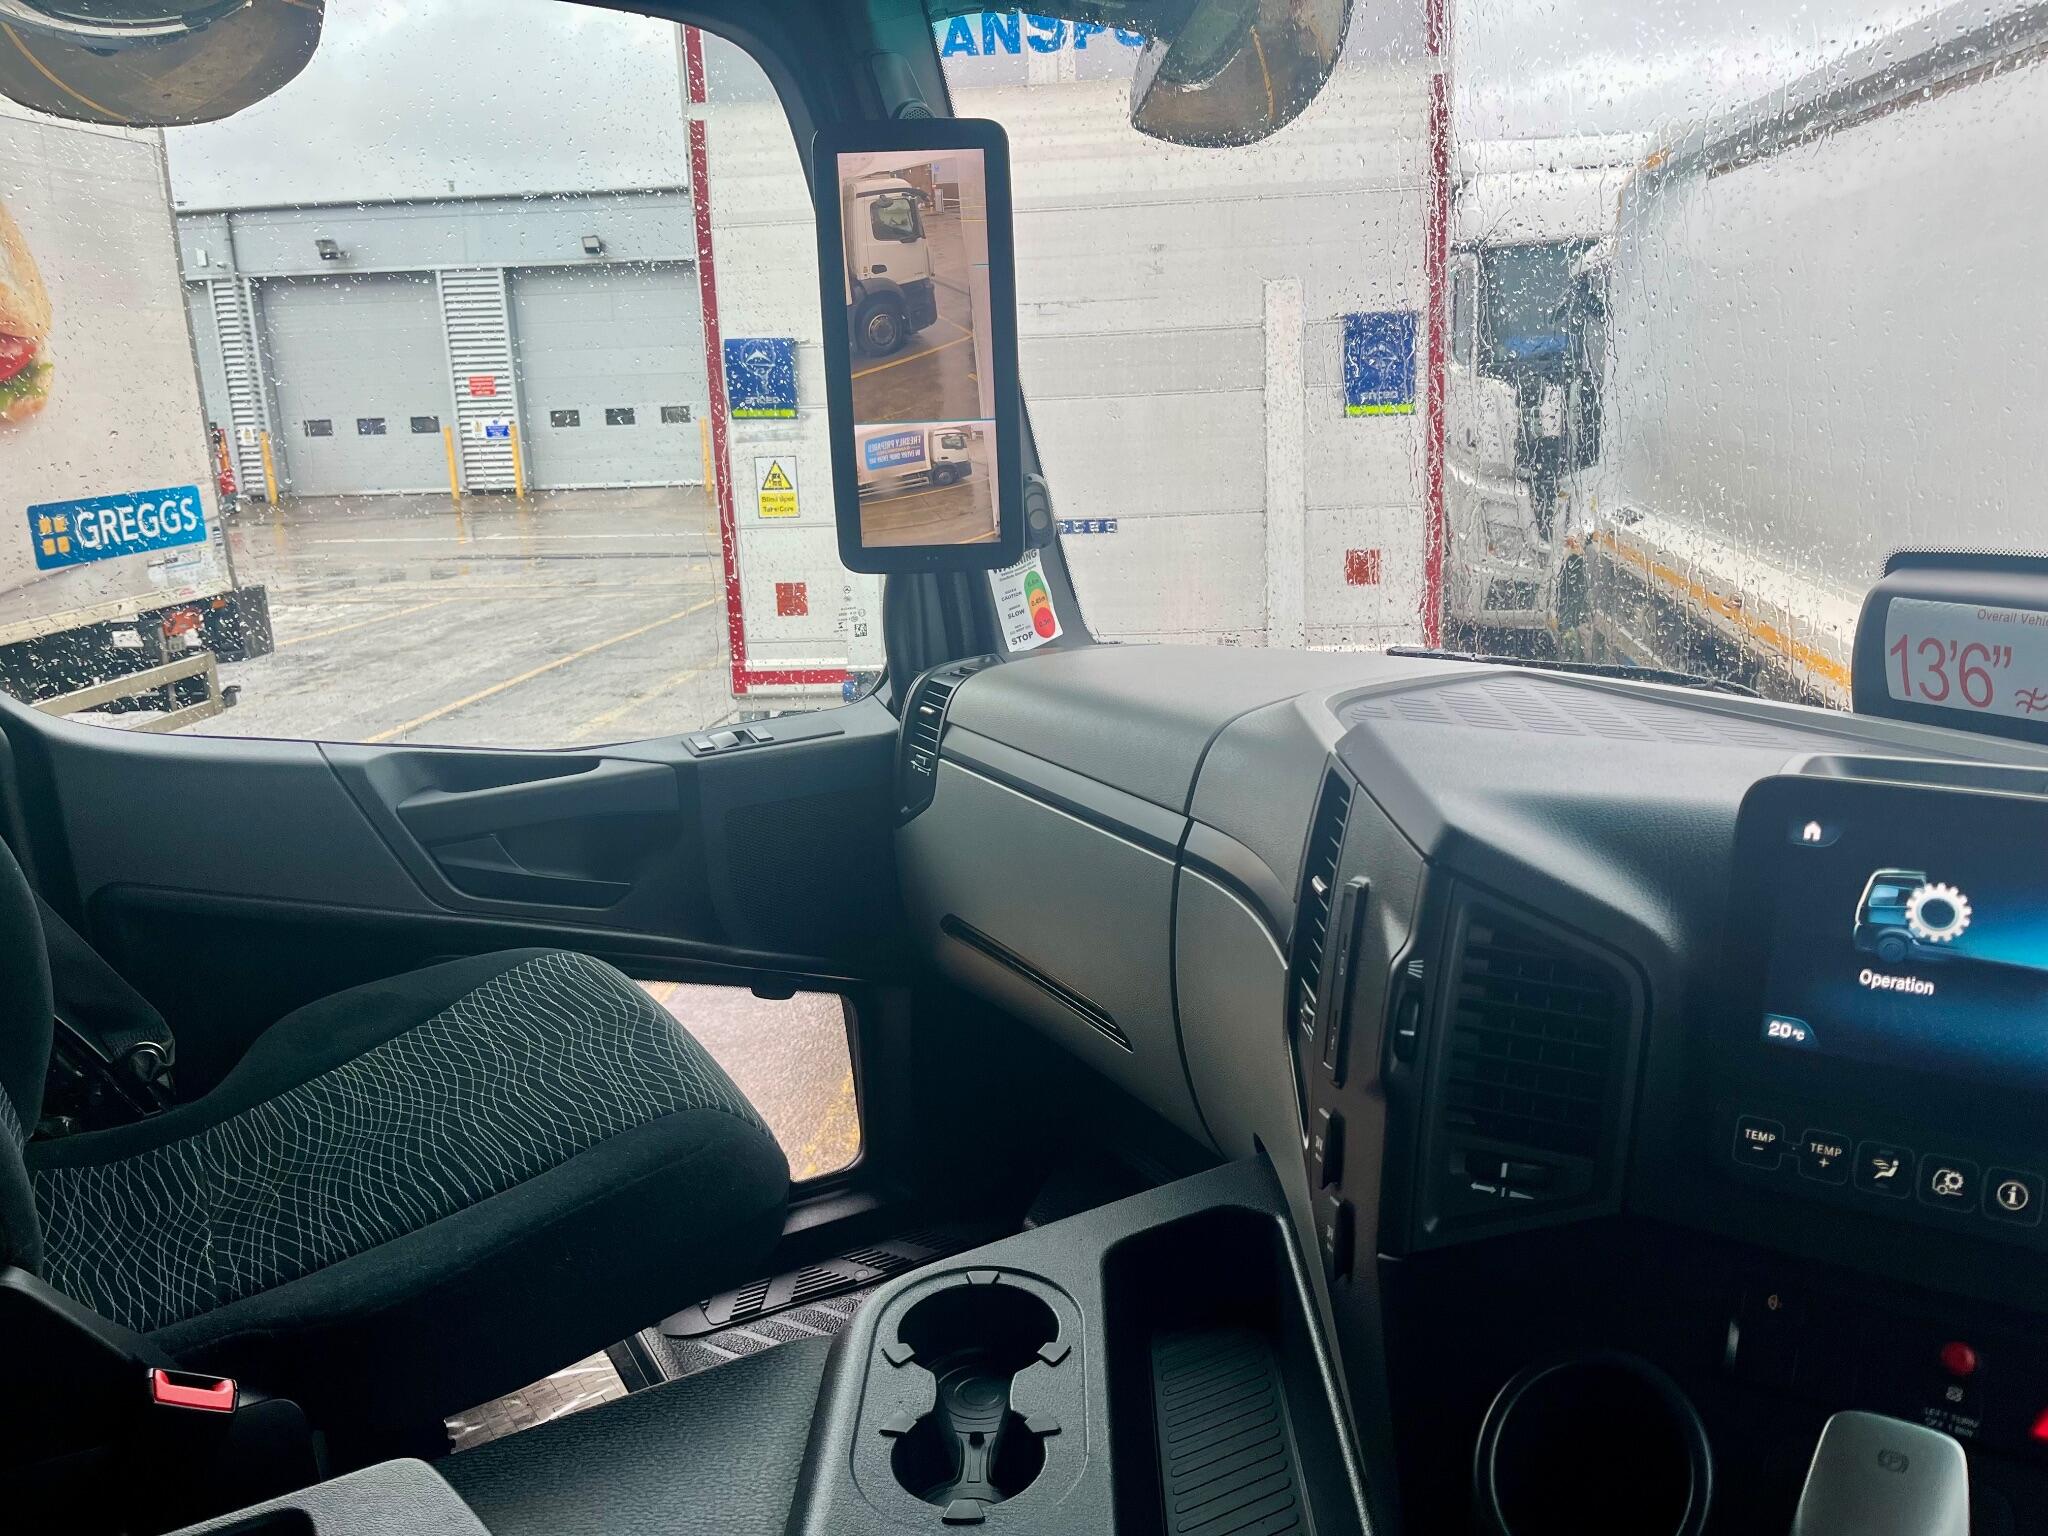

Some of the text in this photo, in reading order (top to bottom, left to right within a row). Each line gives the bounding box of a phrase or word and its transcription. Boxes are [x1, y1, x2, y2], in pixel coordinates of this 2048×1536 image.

[77, 498, 197, 548] GREGGS
[1007, 608, 1025, 620] SLOW
[1977, 608, 2017, 624] Overall
[1011, 631, 1034, 646] STOP
[1859, 968, 1935, 996] Operation
[1744, 1128, 1776, 1143] TEMP
[1810, 1142, 1843, 1157] TEMP
